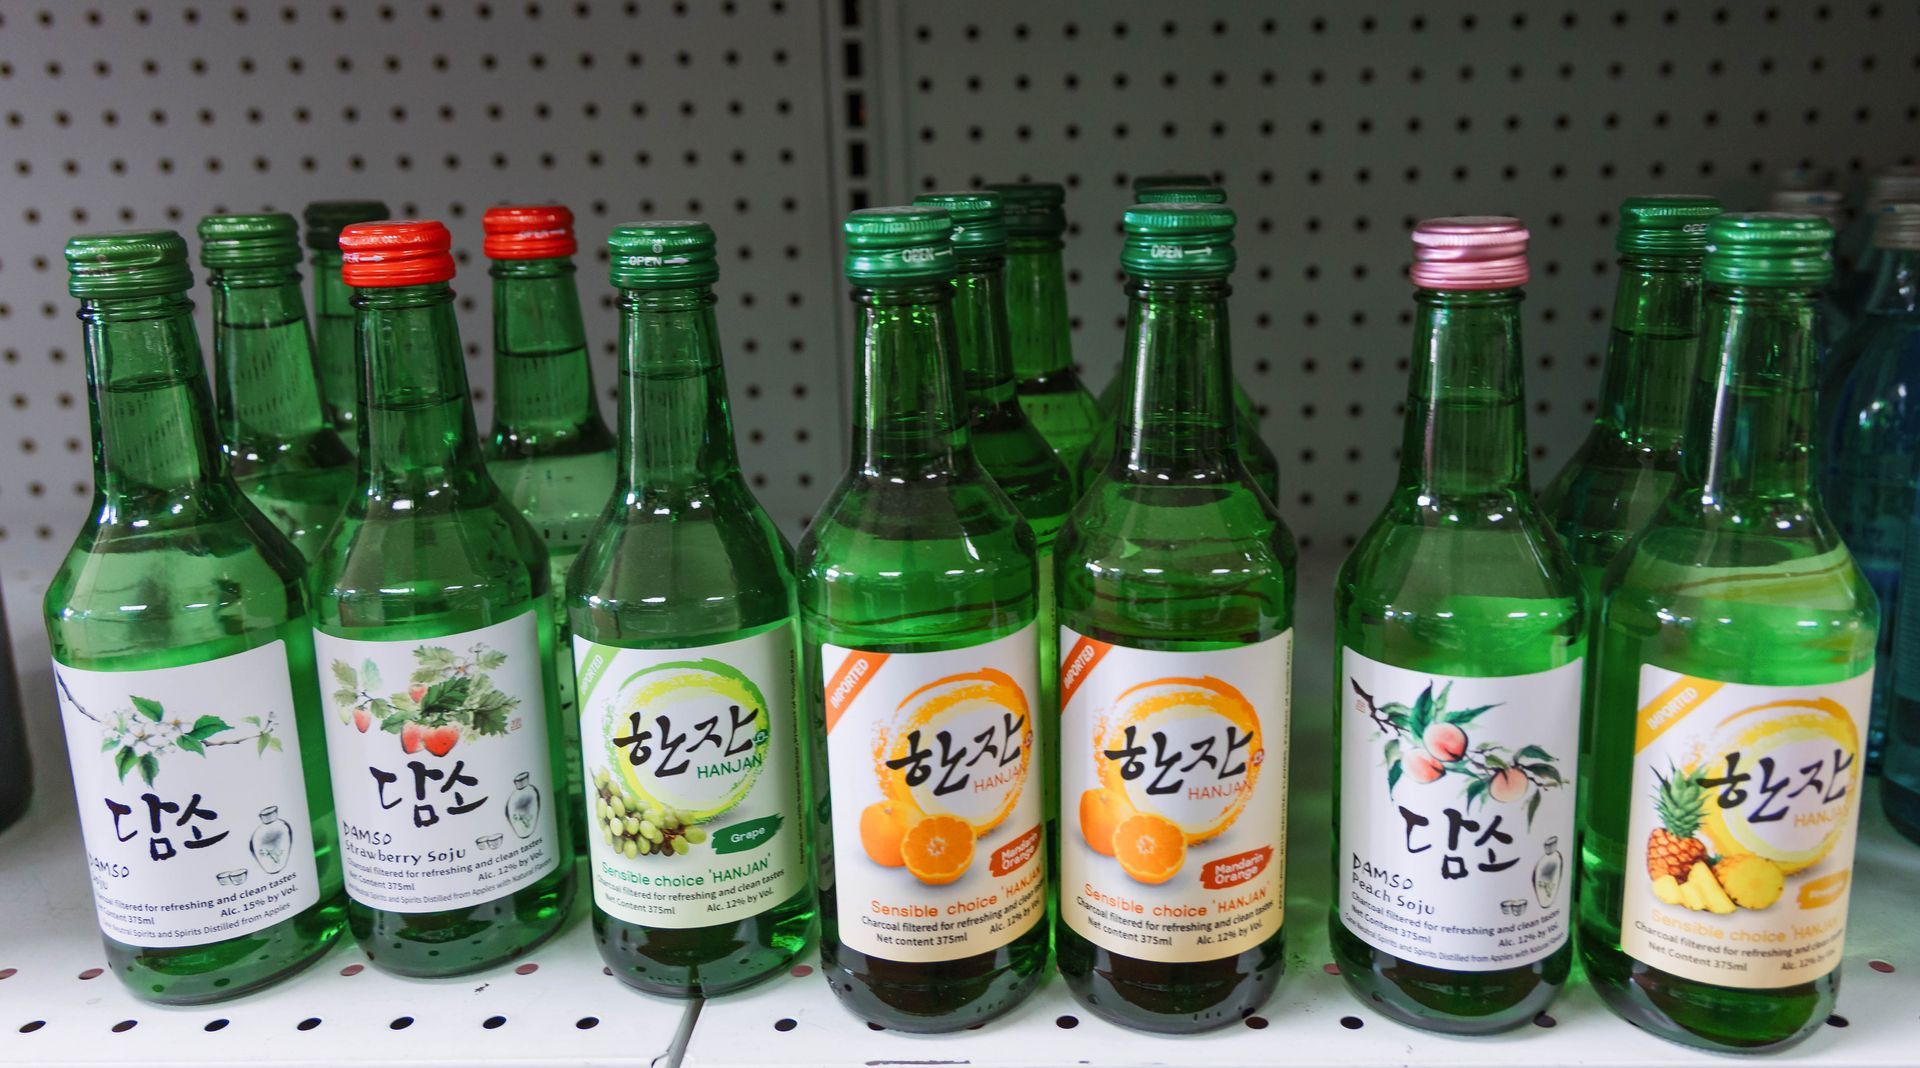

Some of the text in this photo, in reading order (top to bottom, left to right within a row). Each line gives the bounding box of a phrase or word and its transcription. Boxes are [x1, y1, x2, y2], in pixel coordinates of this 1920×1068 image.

[628, 256, 662, 266] OPEN
[902, 248, 935, 263] OPEN
[1150, 245, 1183, 259] OPEN
[1063, 644, 1096, 690] IMPORTED
[829, 658, 870, 709] IMPORTED
[1647, 686, 1698, 731] IMPORTED
[612, 705, 760, 778] 한잔
[697, 753, 762, 779] HANJAN
[886, 712, 1025, 797] 한잔
[1104, 725, 1254, 796] 한잔
[368, 760, 489, 828] 담소
[1188, 780, 1252, 801] HANJAN
[1696, 748, 1855, 824] 한잔
[104, 793, 230, 862] 담소
[343, 820, 392, 845] DAMSO
[730, 827, 766, 843] Grape
[345, 839, 466, 866] Strawberry Soju
[1398, 805, 1521, 880] 담소
[406, 870, 419, 878] for
[422, 864, 473, 878] refreshing
[475, 858, 494, 869] and
[495, 849, 519, 863] clean
[478, 872, 496, 882] Alc.
[498, 864, 518, 875] 12%
[519, 858, 528, 867] by
[602, 862, 650, 886] Sensible
[654, 875, 705, 887] choice
[1214, 852, 1264, 875] Mandarin
[1214, 866, 1258, 885] Orange
[1352, 852, 1414, 890] DAMSO
[145, 903, 158, 912] for
[161, 900, 215, 912] refreshing
[216, 893, 237, 905] and
[239, 885, 267, 899] clean
[268, 872, 297, 888] tastes
[388, 882, 416, 891] 375ml
[654, 892, 666, 900] for
[668, 890, 717, 901] refreshing
[718, 886, 736, 897] and
[737, 880, 761, 893] clean
[1352, 872, 1435, 916] Peach Soju
[220, 884, 299, 917] Alc. 15% by Vol.
[648, 904, 676, 914] 375ml
[706, 904, 725, 912] Alc.
[726, 898, 746, 909] 12%
[747, 894, 758, 904] by
[871, 900, 938, 918] Sensible
[946, 895, 998, 915] choice
[1084, 883, 1144, 914] Sensible
[1152, 904, 1208, 918] choice
[158, 930, 173, 938] and
[174, 928, 202, 938] Spirits
[204, 920, 240, 934] Distilled
[242, 914, 263, 925] from
[264, 903, 291, 917] Apples
[861, 916, 900, 932] Charcoal
[902, 922, 938, 932] filtered
[940, 920, 955, 931] for
[957, 909, 1003, 928] refreshing
[990, 922, 1006, 934] Alc.
[1110, 912, 1143, 928] filtered
[1146, 920, 1160, 931] for
[1162, 921, 1213, 933] refreshing
[1214, 917, 1232, 930] and
[1232, 912, 1254, 926] clean
[1424, 920, 1438, 932] for
[1440, 926, 1496, 937] refreshing
[1497, 924, 1516, 934] and
[1517, 919, 1540, 931] clean
[876, 932, 968, 946] Net content 375ml
[1103, 925, 1139, 942] content
[1140, 934, 1173, 946] 375ml
[1196, 934, 1216, 945] Alc.
[1217, 928, 1236, 942] 12%
[1238, 926, 1248, 938] by
[1401, 928, 1432, 944] 375ml
[1634, 920, 1678, 944] Charcoal
[1680, 938, 1721, 954] filtered
[1723, 946, 1739, 956] for
[1741, 948, 1793, 958] refreshing
[1729, 928, 1787, 943] choice
[1648, 941, 1748, 971] Net Content 375ml
